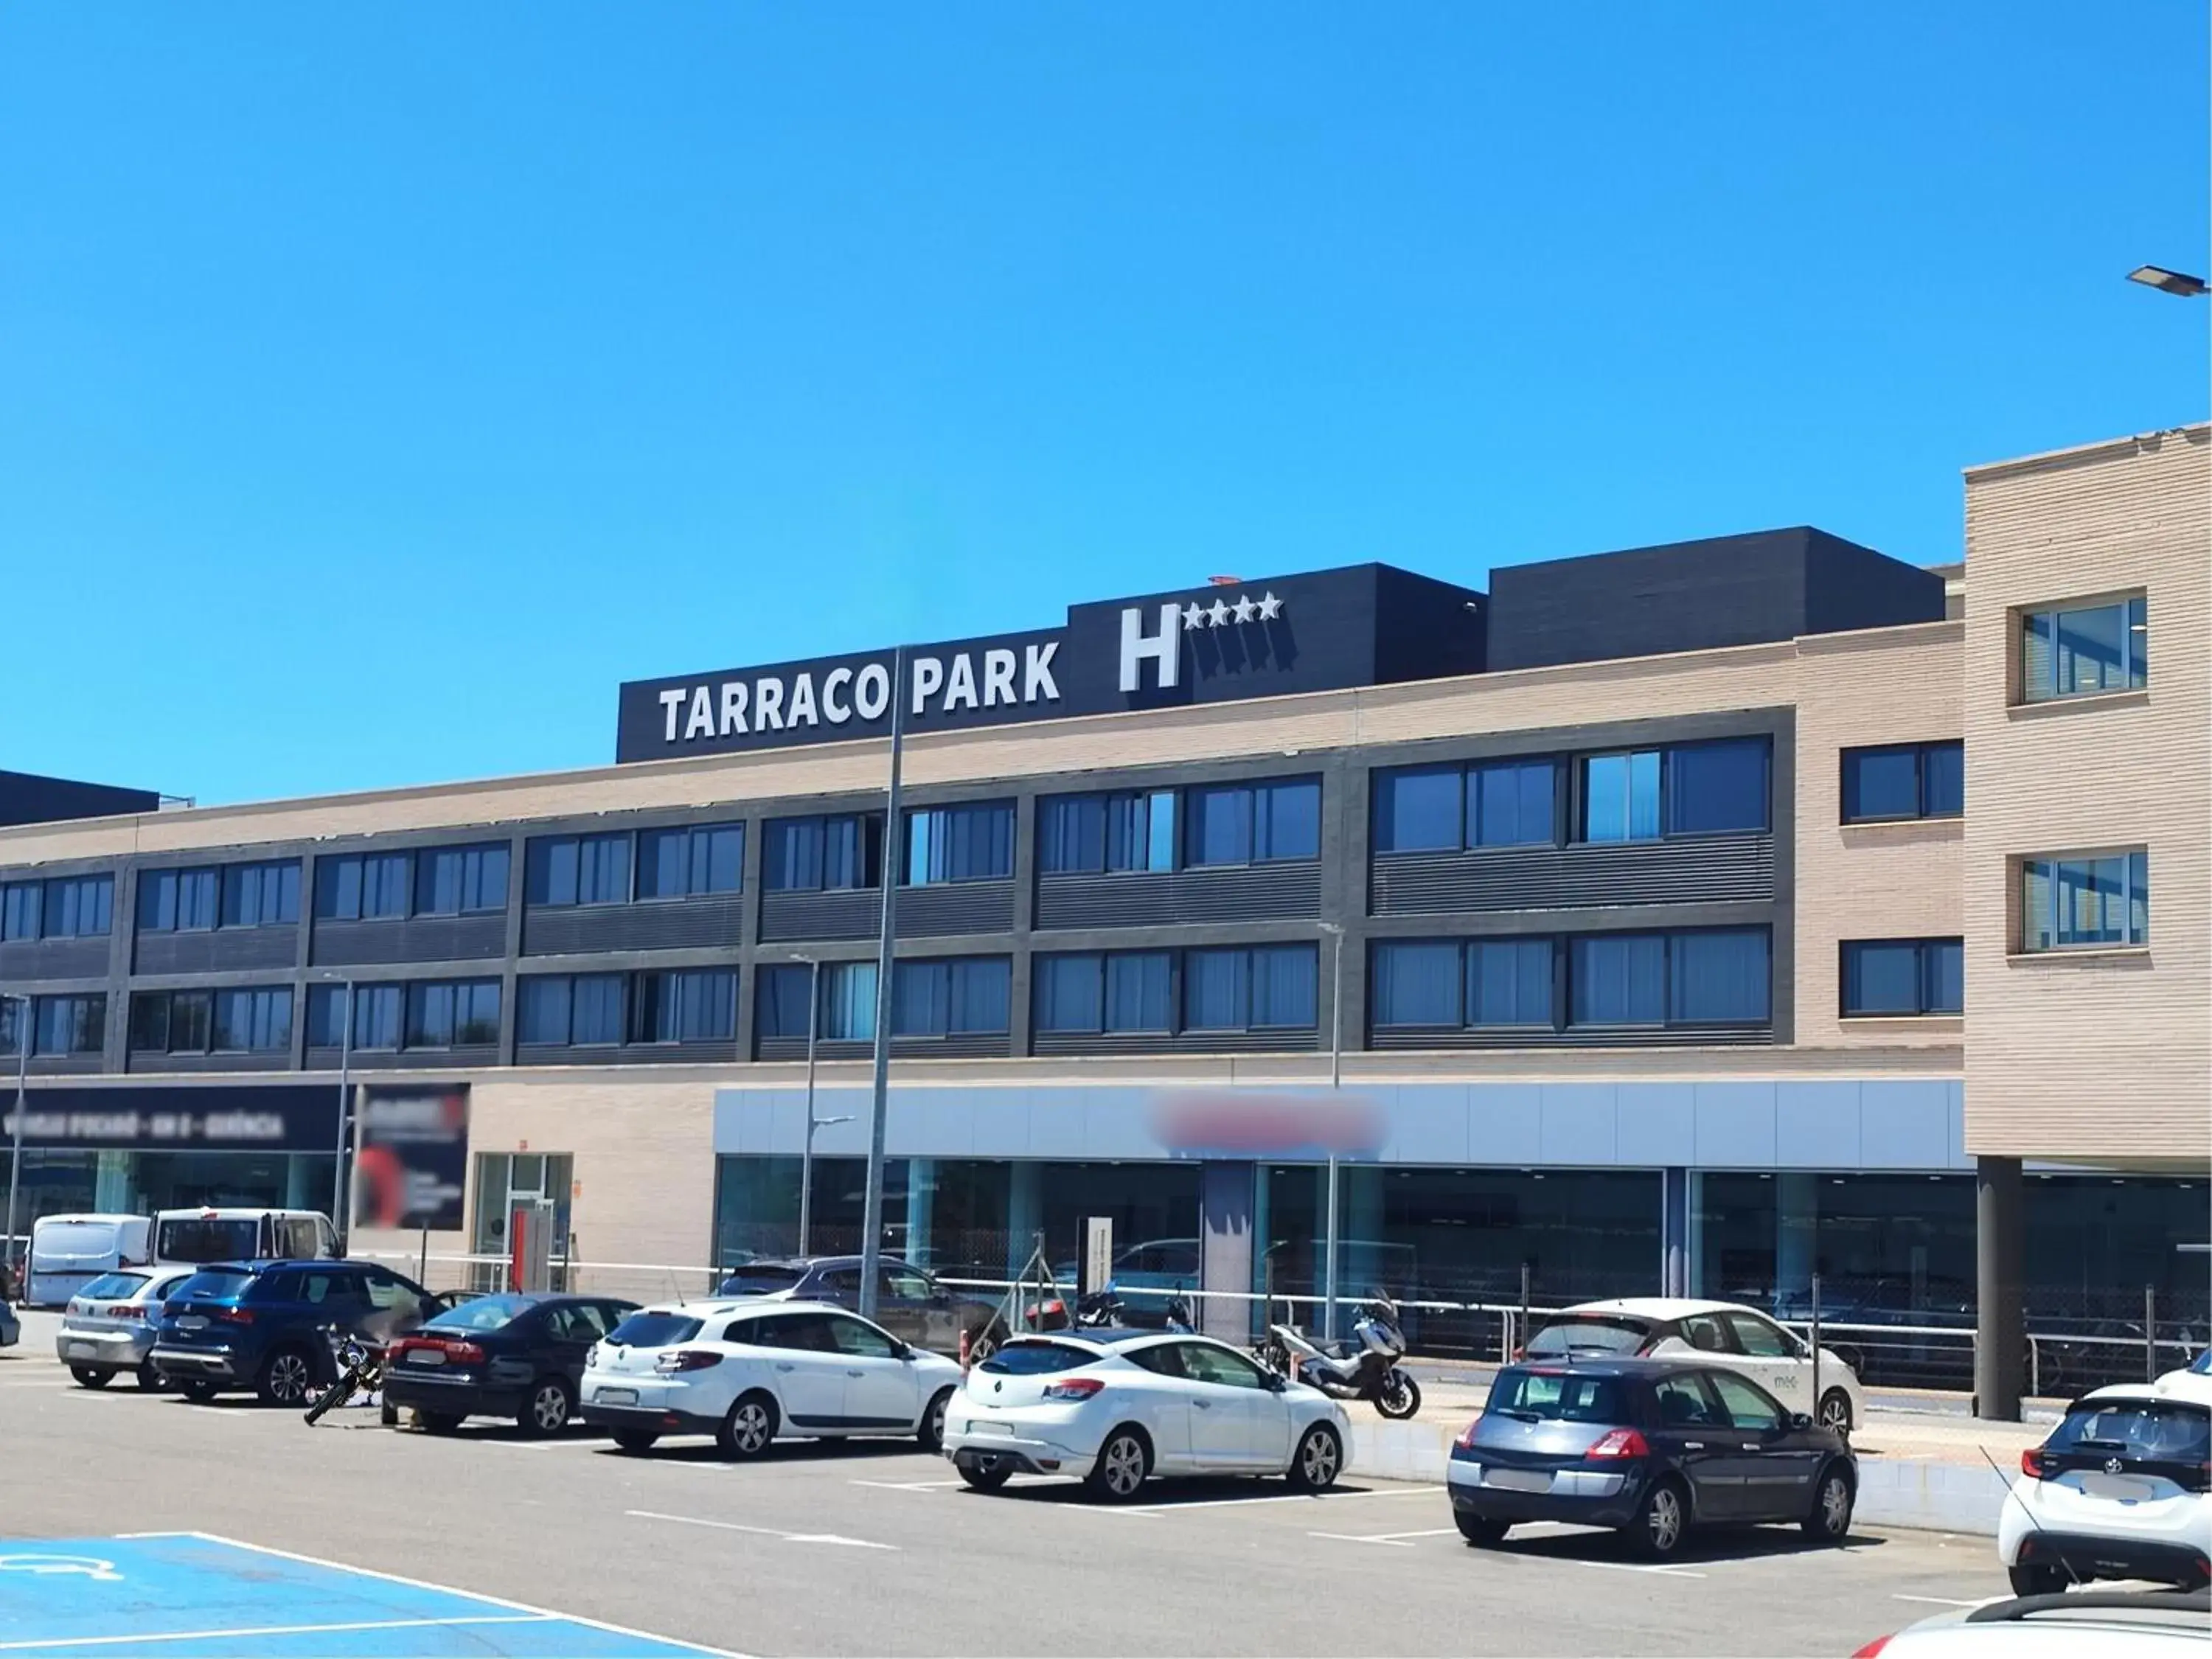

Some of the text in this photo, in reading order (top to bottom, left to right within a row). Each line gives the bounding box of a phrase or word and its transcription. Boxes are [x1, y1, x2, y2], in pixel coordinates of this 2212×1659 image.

[659, 641, 1060, 740] TARRACO PARK
[1119, 603, 1180, 692] H
